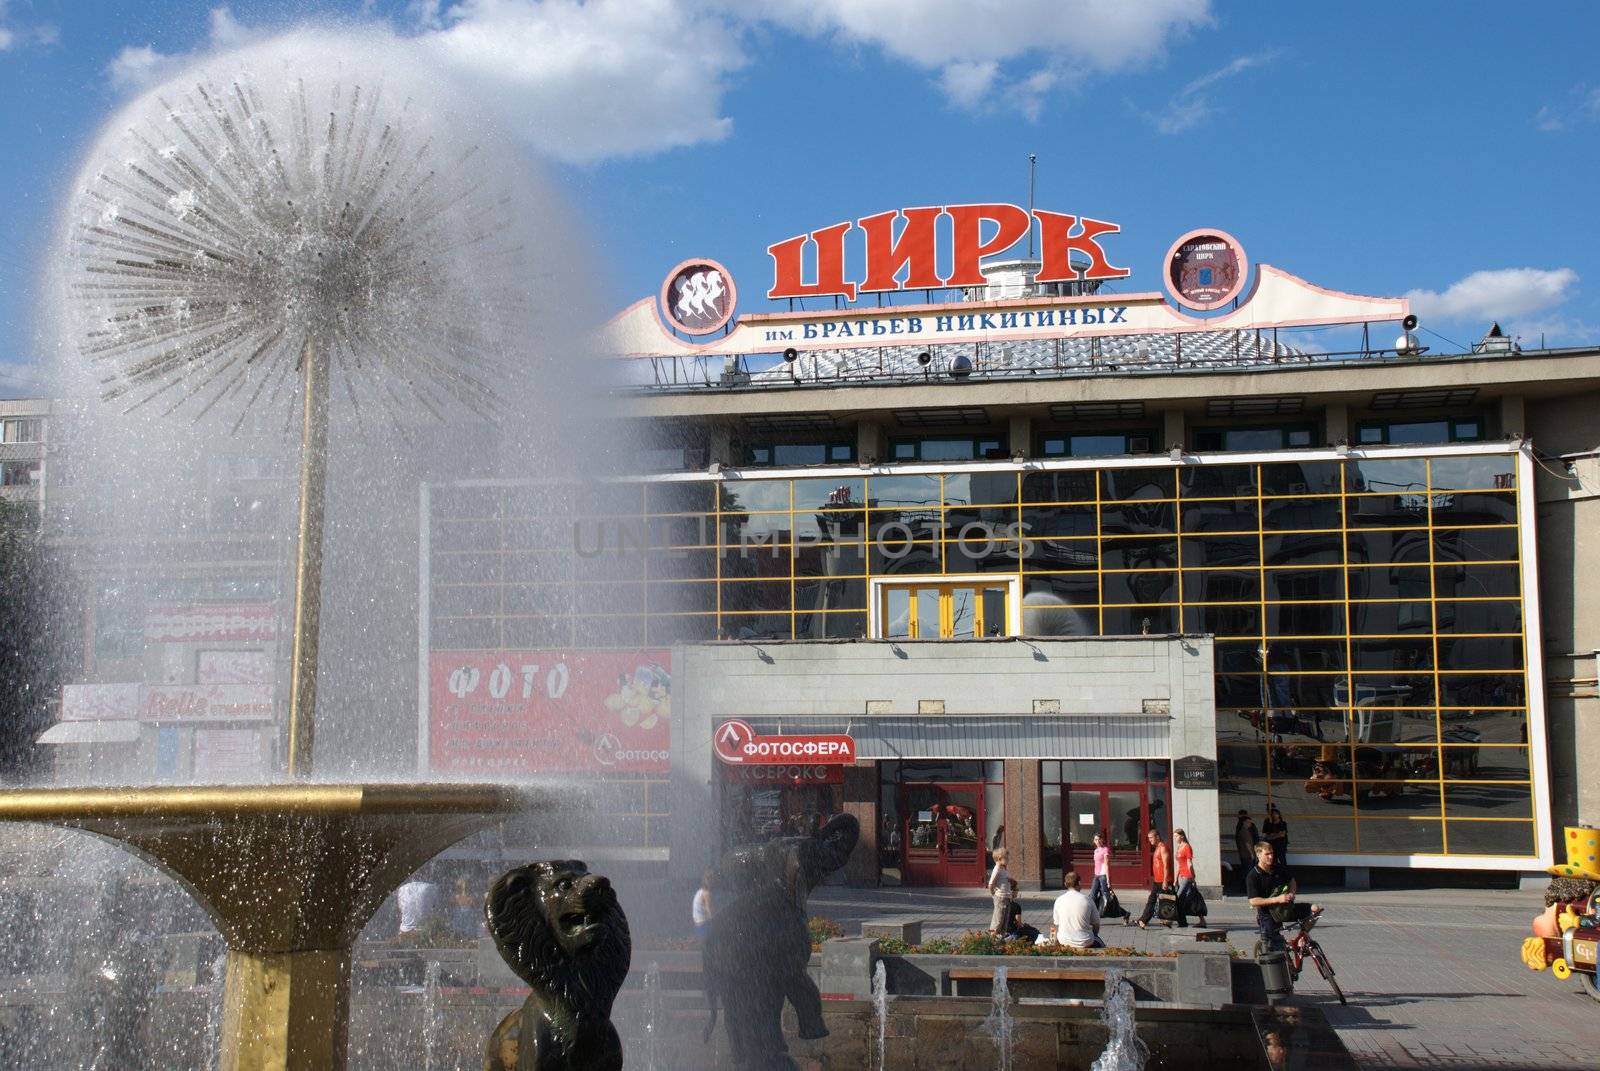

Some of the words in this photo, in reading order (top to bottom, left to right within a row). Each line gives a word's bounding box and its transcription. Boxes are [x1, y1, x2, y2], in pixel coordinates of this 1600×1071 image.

[767, 202, 1131, 303] ЦИРК
[803, 317, 923, 340] БРАТЬЕВ
[935, 306, 1128, 332] НИКИТИНЫХ
[448, 662, 569, 699] ФОТО
[743, 742, 850, 756] ФОТОСФЕРА
[741, 765, 827, 779] КСЕРОКС
